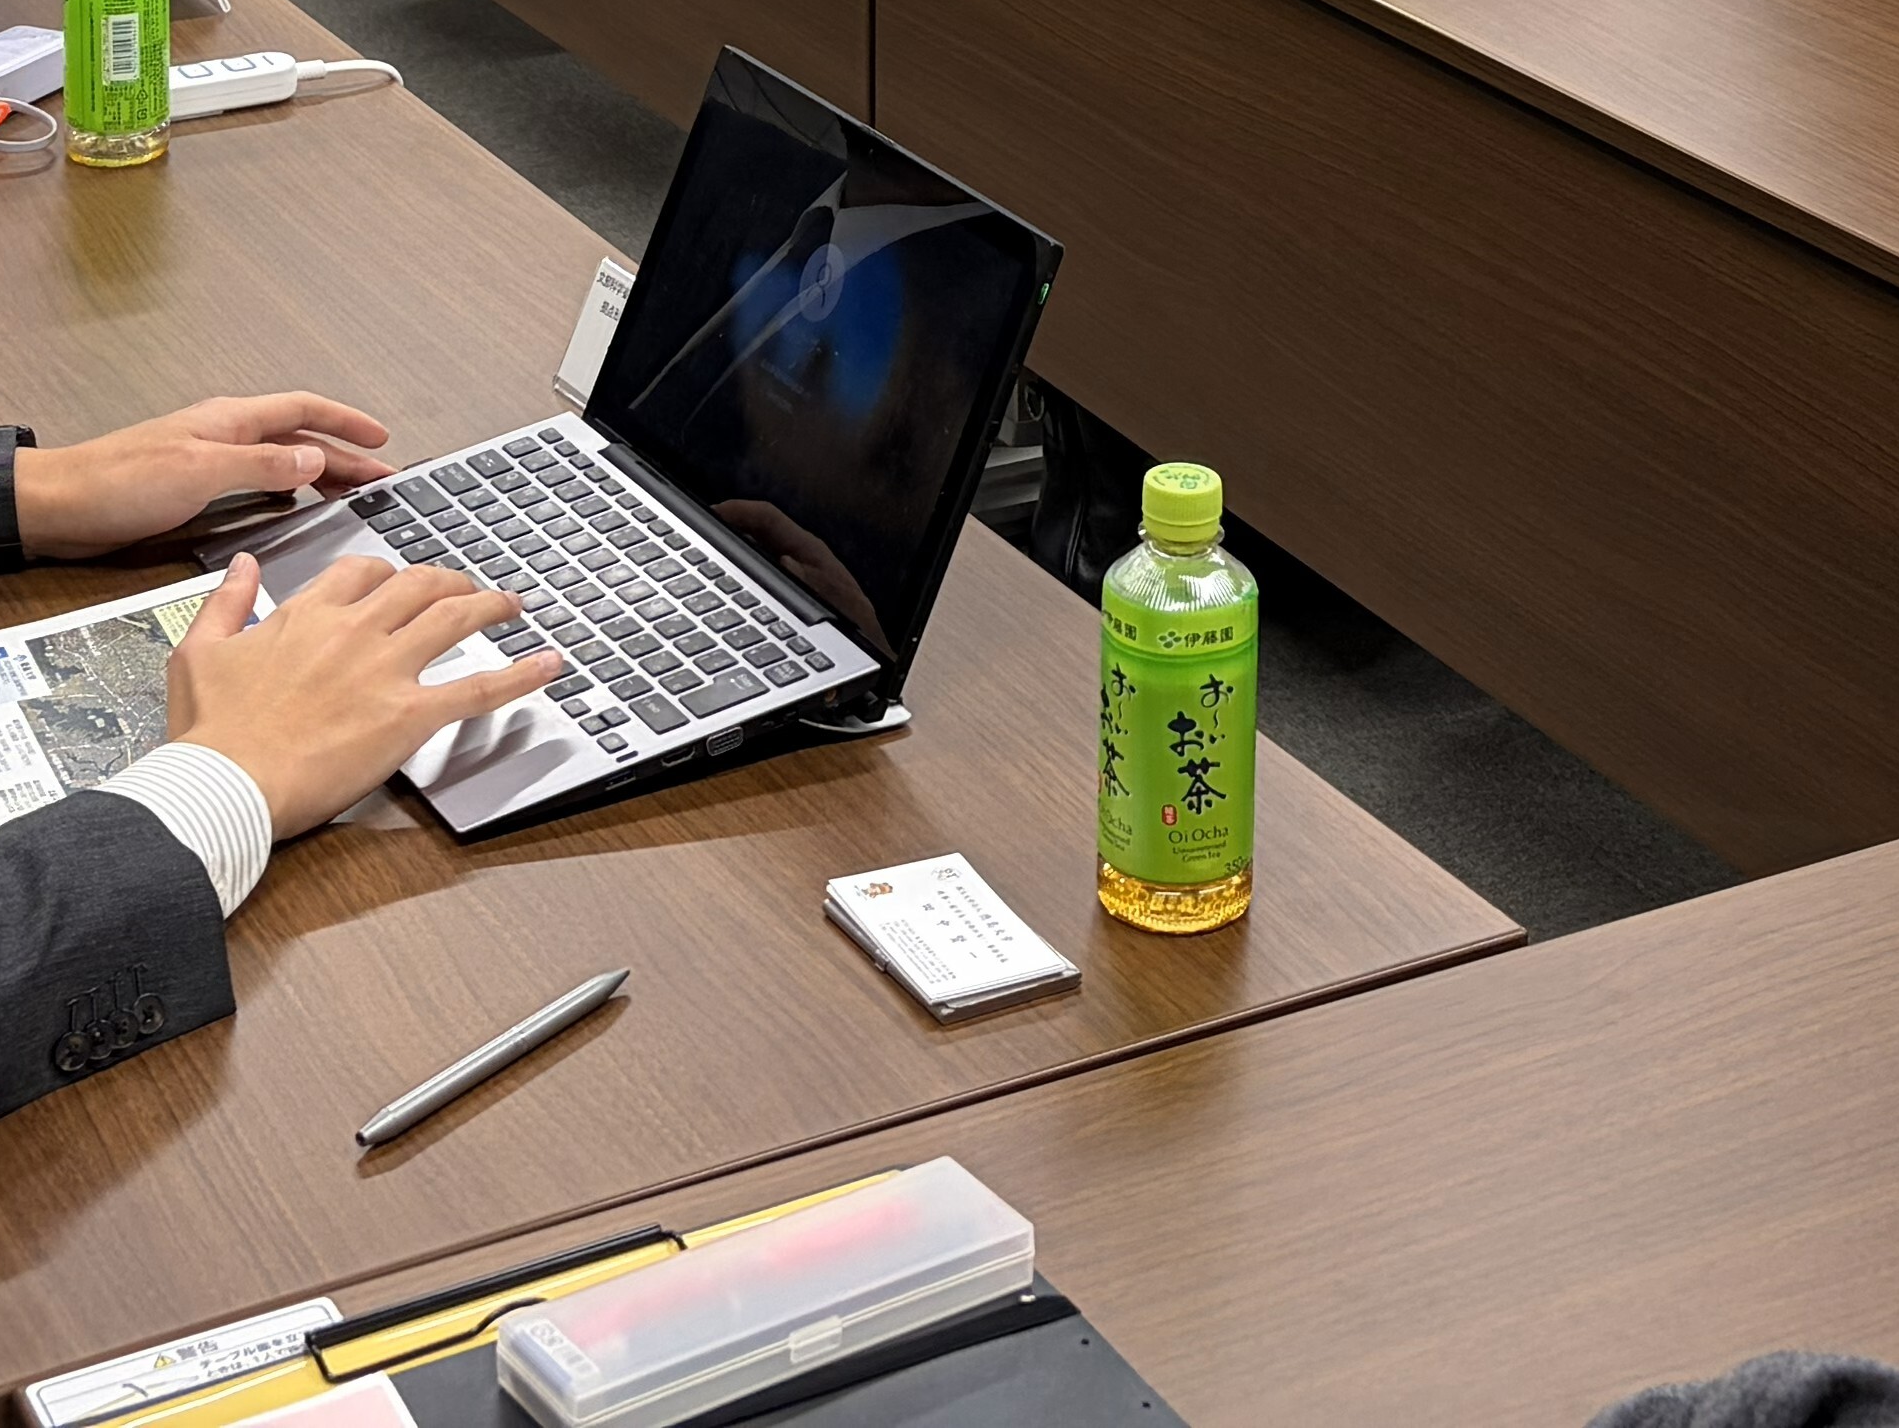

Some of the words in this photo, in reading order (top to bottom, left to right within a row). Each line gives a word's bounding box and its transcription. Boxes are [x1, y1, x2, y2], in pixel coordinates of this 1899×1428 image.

[1184, 626, 1234, 648] 伊藤園
[1168, 711, 1227, 815] お茶
[1192, 826, 1229, 842] Ocha
